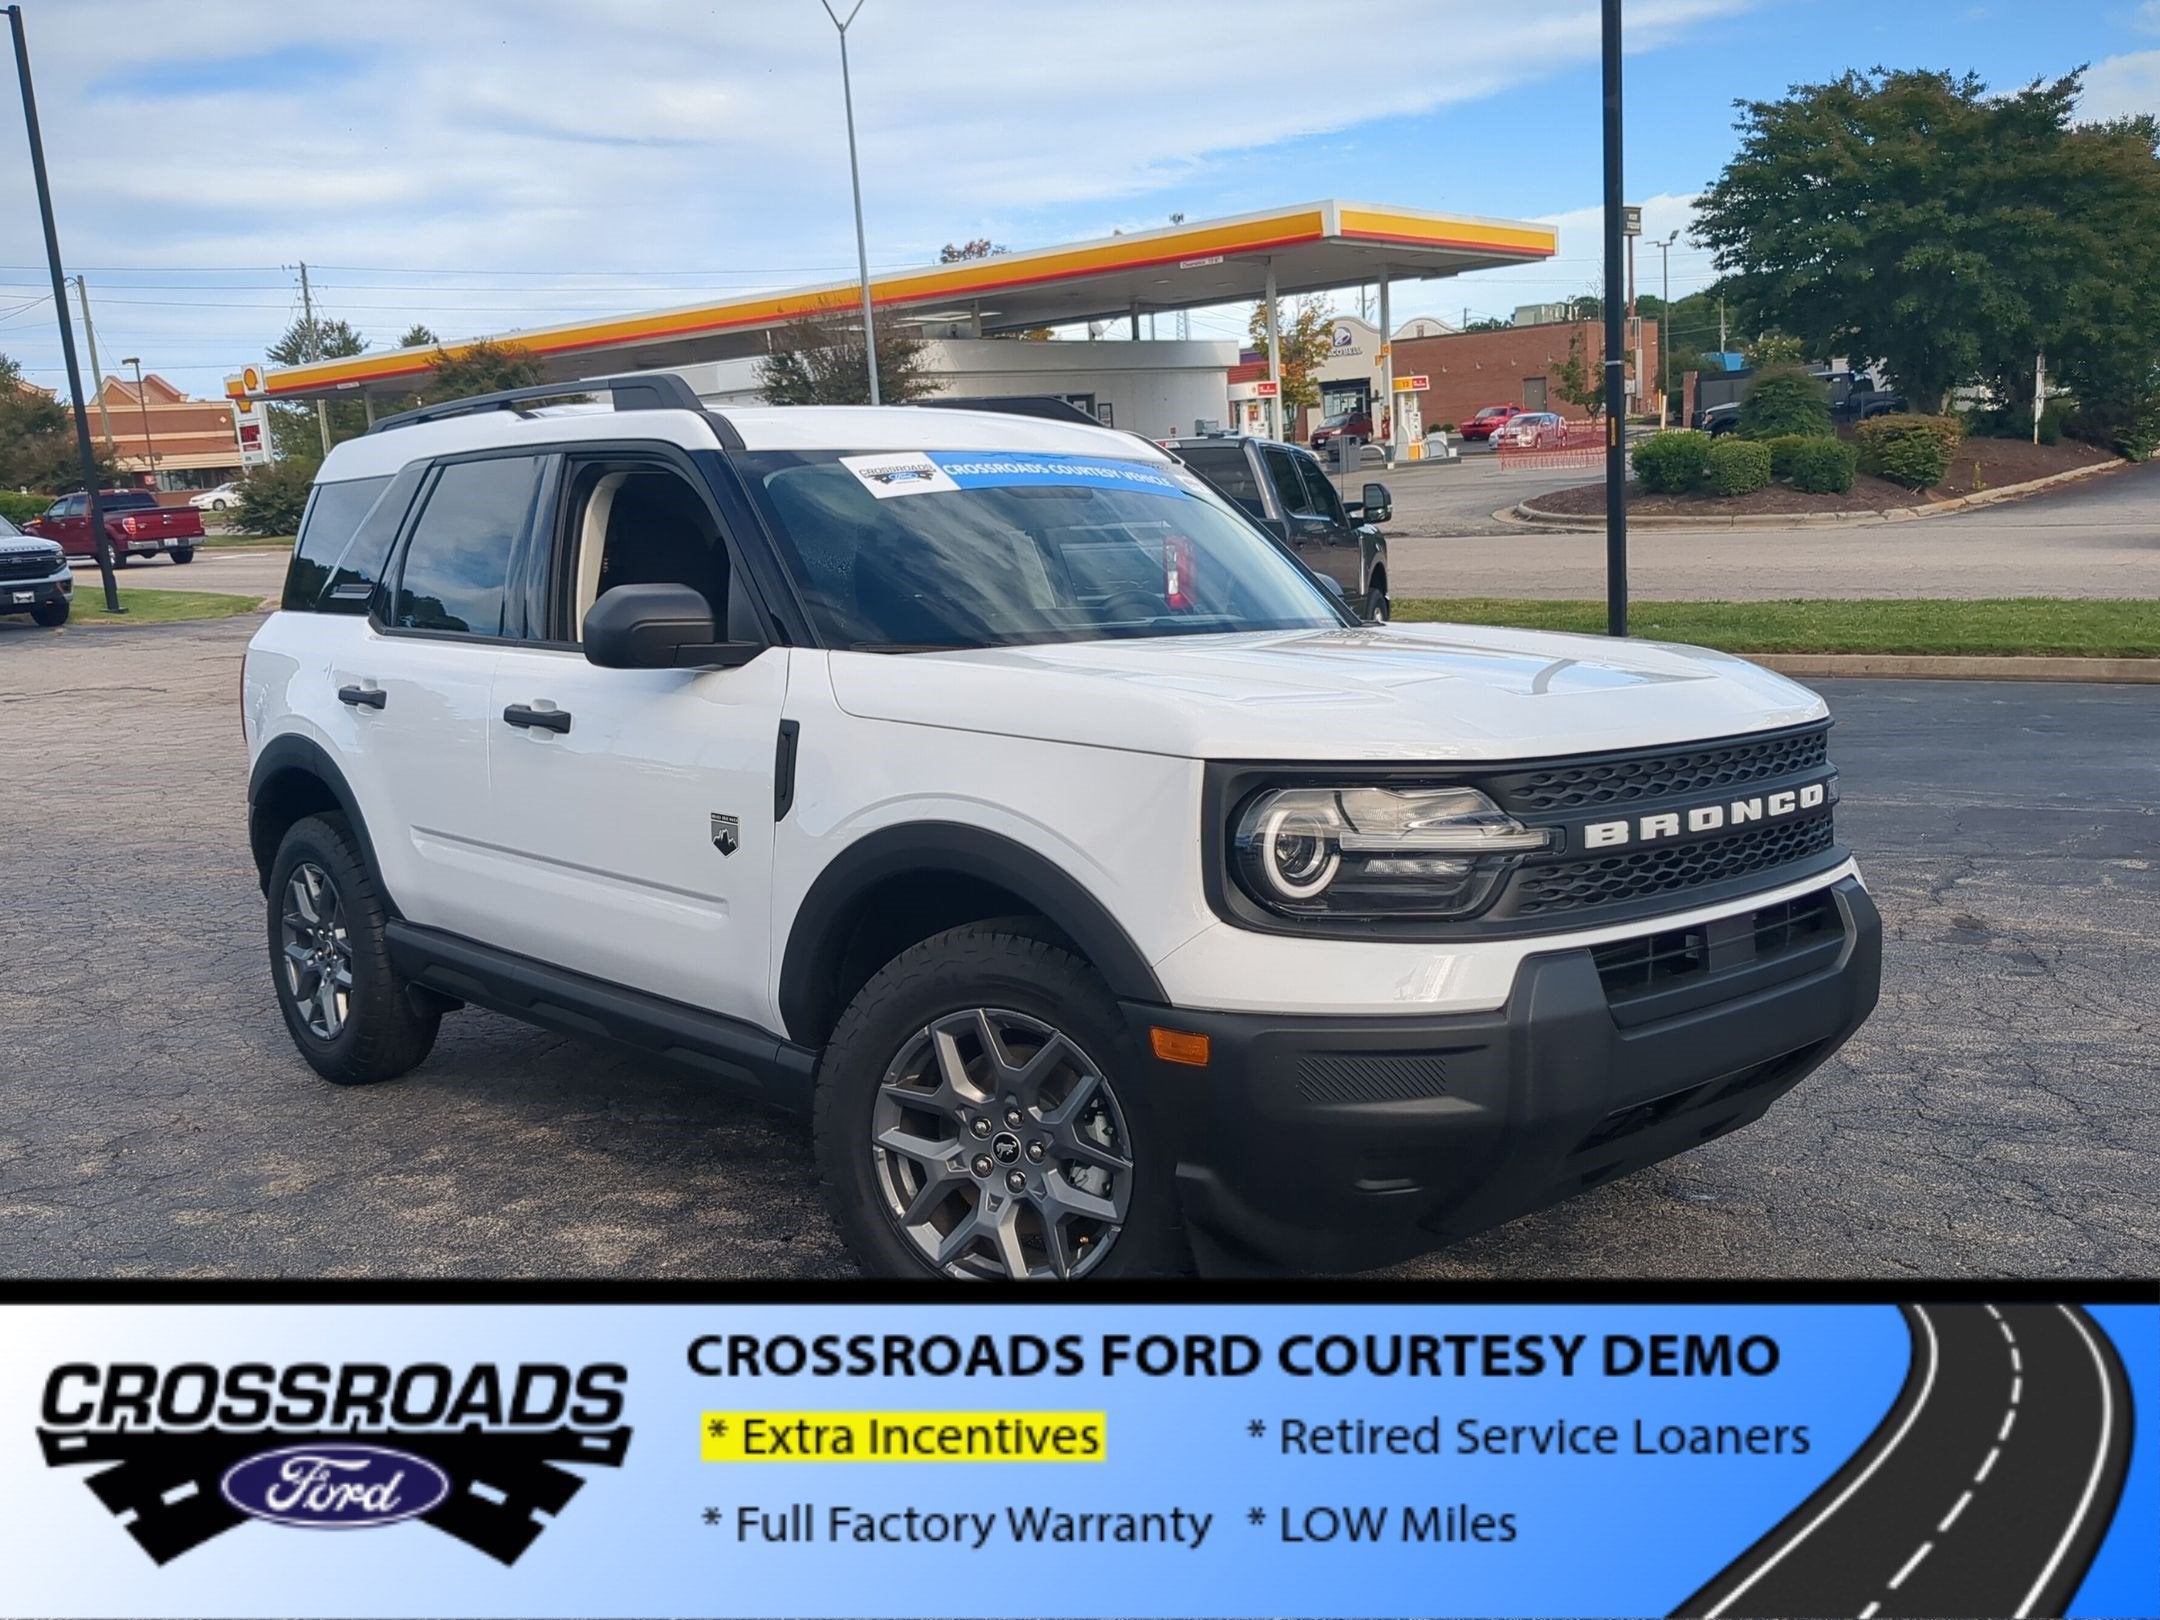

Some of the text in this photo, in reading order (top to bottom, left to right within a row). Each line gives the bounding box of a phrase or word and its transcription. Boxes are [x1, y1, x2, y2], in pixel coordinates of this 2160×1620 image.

[858, 463, 933, 478] CROSSROADS
[942, 463, 1176, 488] CROSSROADS COURTESY VEHICLE
[1584, 783, 1824, 849] BRONCO
